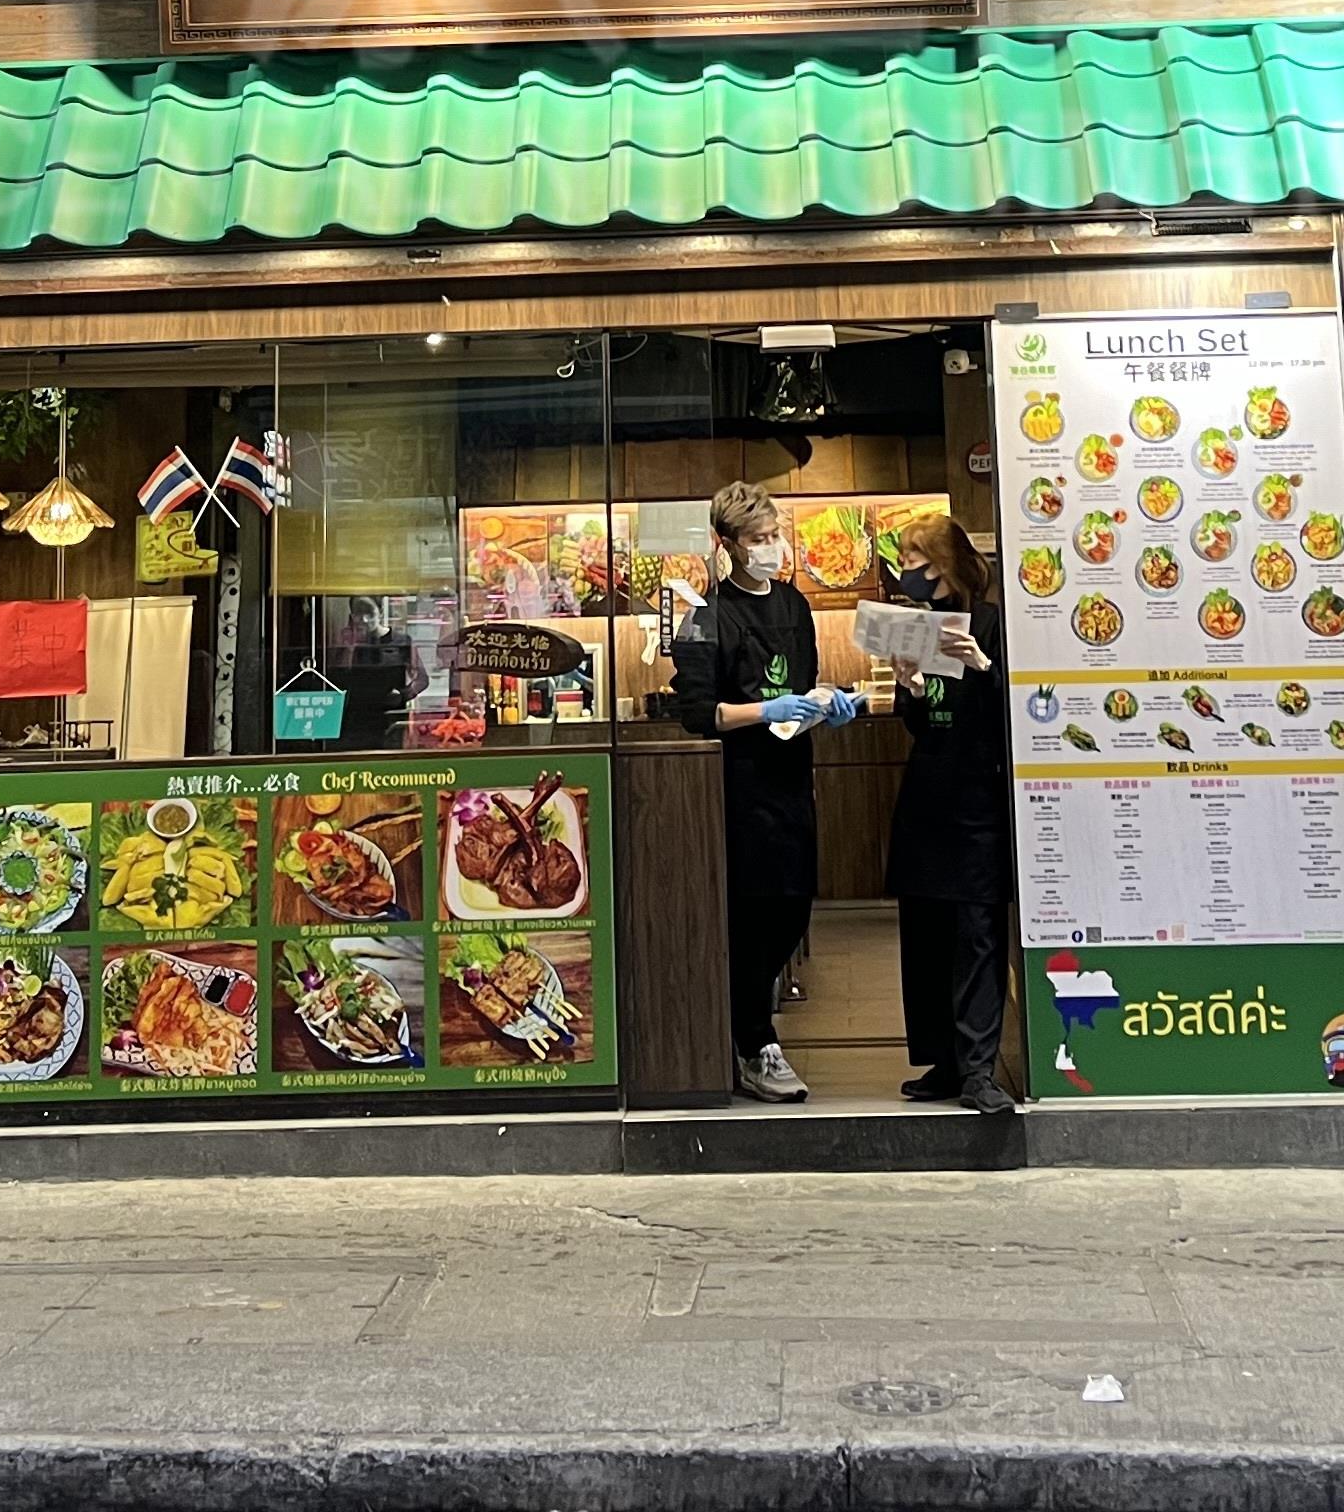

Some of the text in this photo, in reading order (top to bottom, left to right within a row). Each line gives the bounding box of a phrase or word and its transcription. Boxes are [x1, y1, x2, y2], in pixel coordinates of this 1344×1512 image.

[1086, 329, 1249, 354] Lunch Set
[1124, 361, 1211, 383] 午餐餐牌
[464, 629, 550, 650] 欢迎光临
[1173, 670, 1228, 681] Additional
[1193, 762, 1229, 773] Drinks
[321, 772, 358, 792] Chef
[359, 769, 456, 788] Recommend
[1122, 986, 1287, 1037] สวัสดีค่ะ
